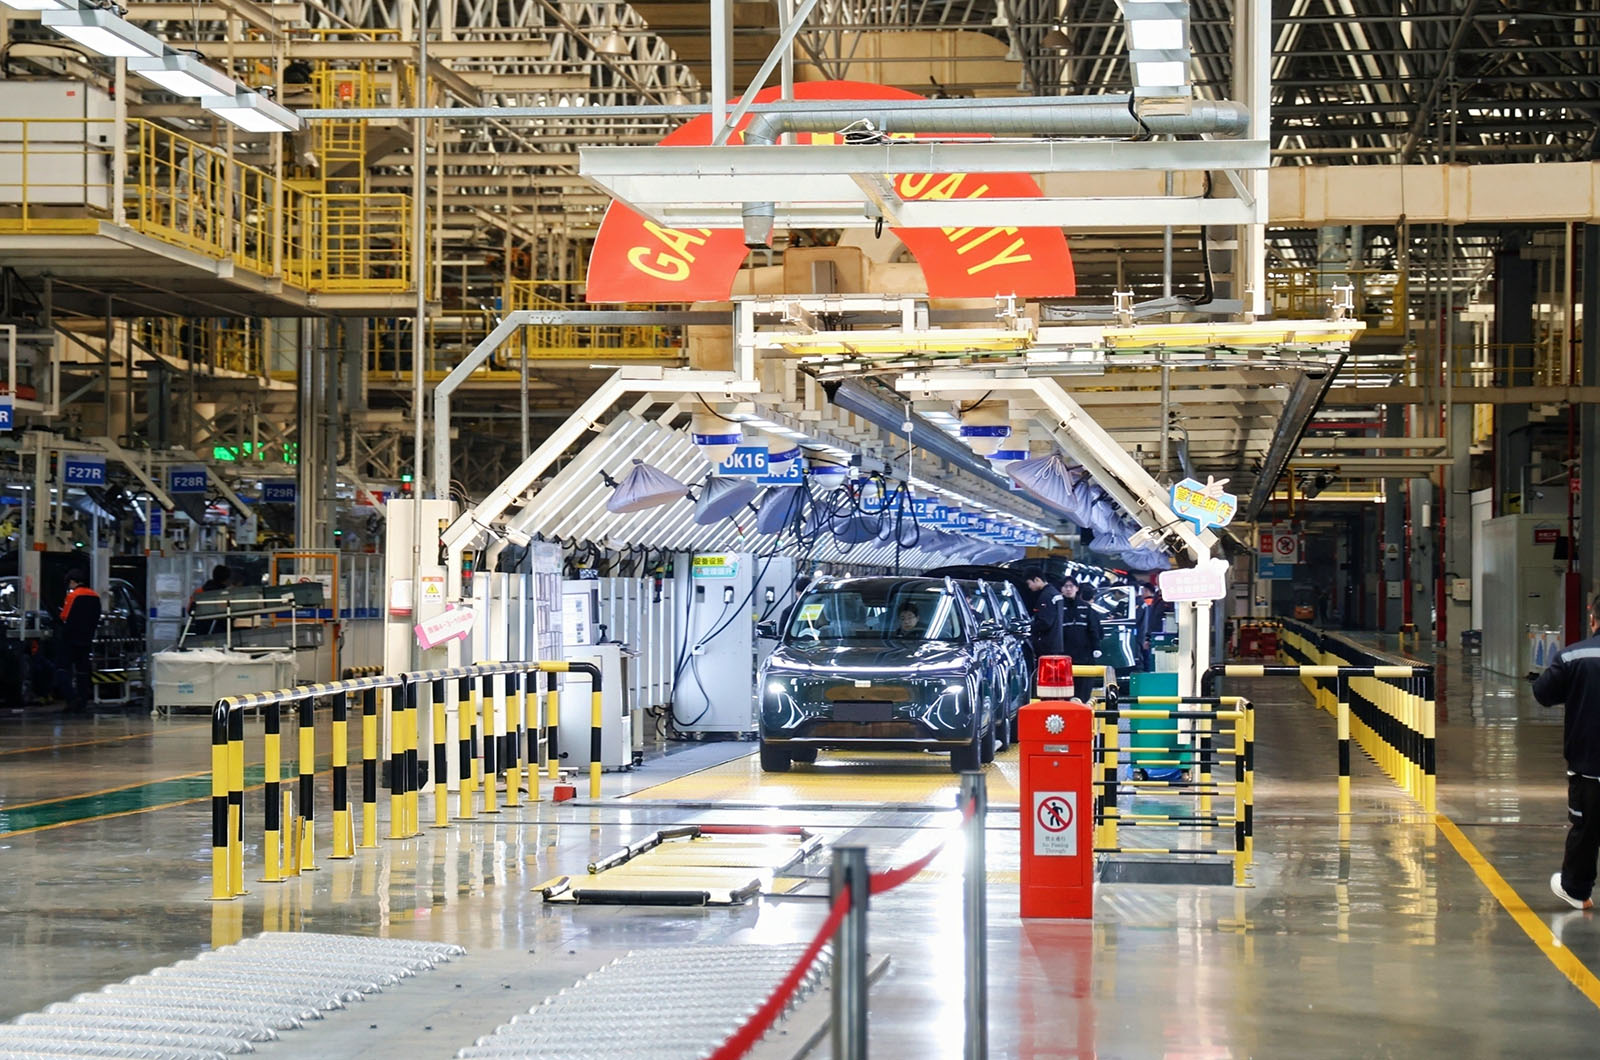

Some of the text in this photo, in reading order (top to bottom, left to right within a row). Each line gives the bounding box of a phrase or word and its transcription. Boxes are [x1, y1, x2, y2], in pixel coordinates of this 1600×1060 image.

[723, 452, 765, 469] OK16
[68, 466, 102, 479] F27R
[173, 476, 204, 488] F28R
[266, 488, 293, 498] F29R
